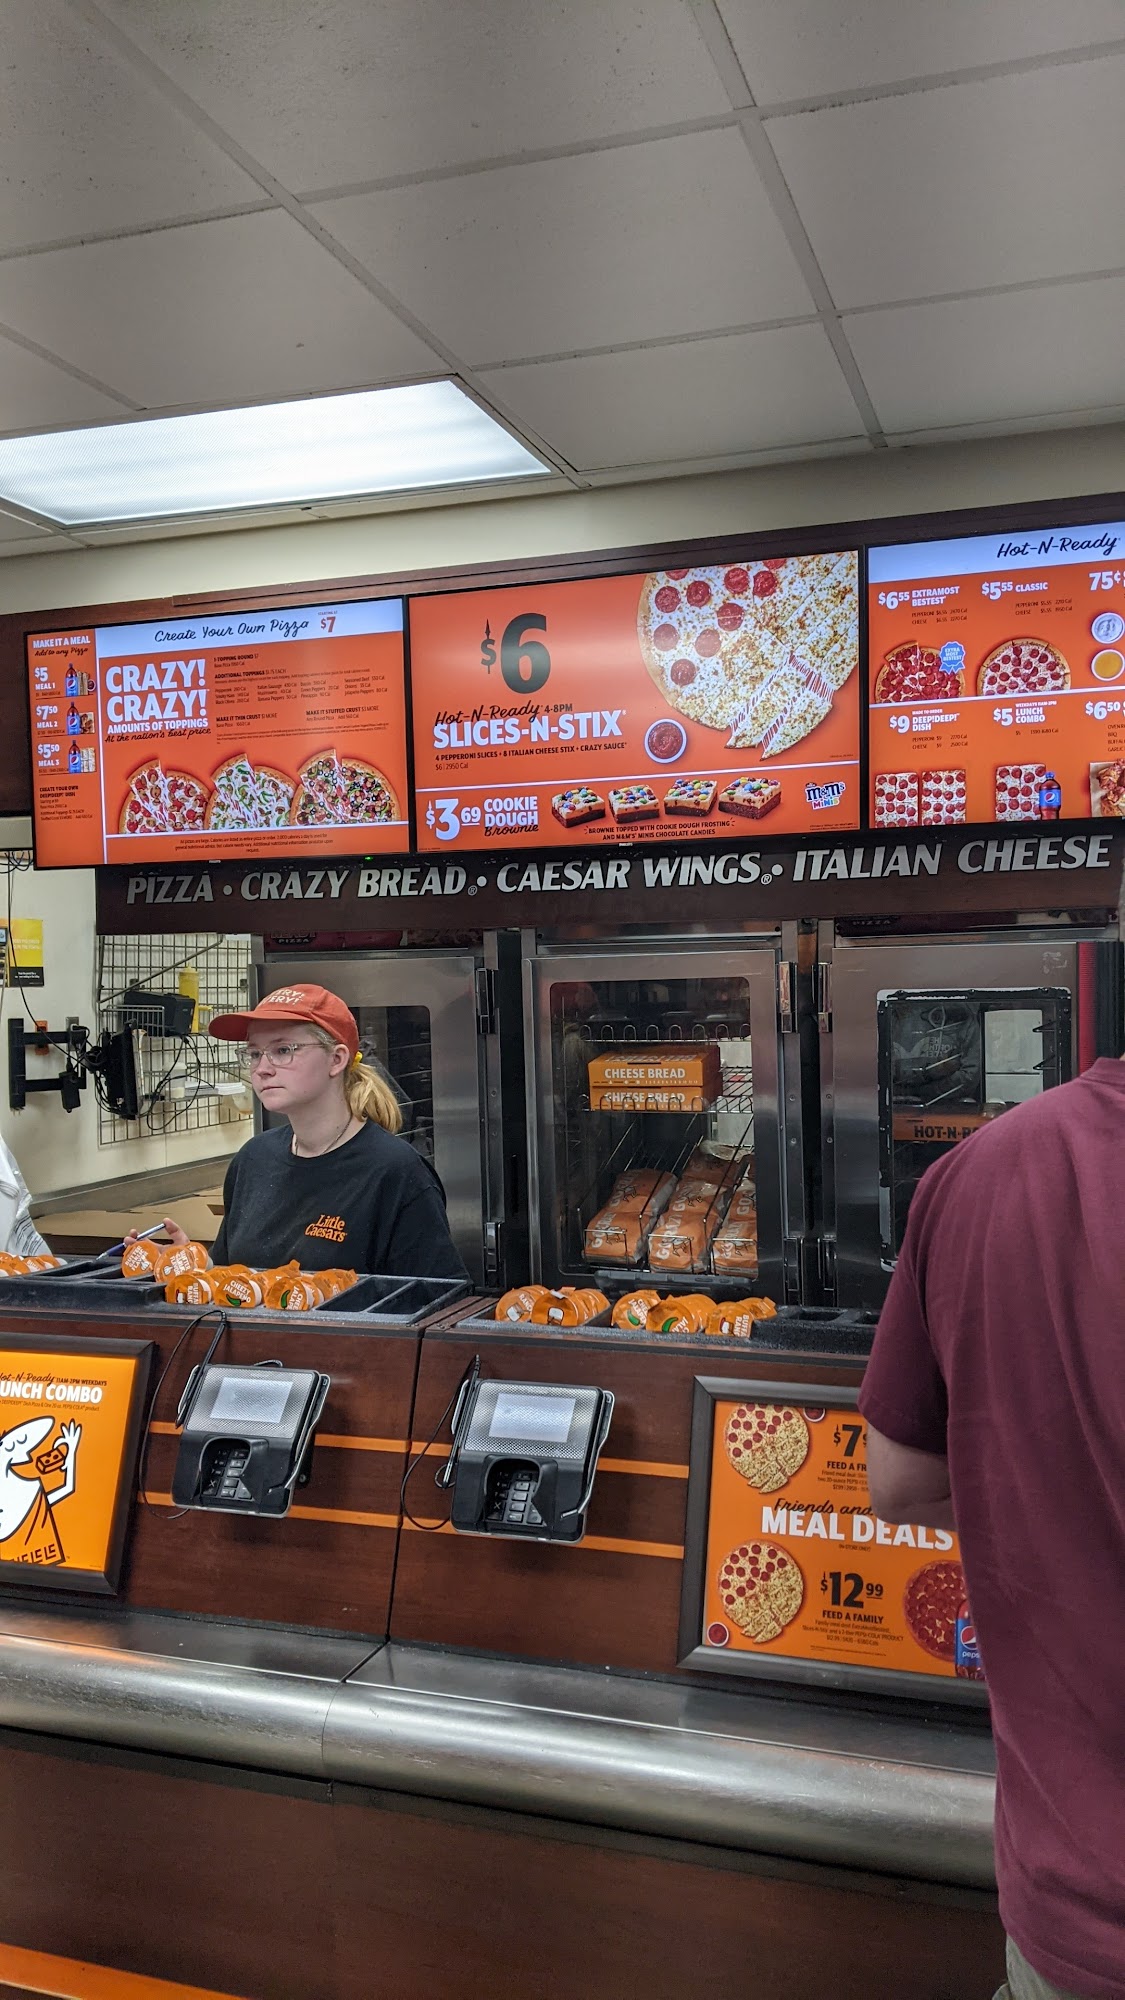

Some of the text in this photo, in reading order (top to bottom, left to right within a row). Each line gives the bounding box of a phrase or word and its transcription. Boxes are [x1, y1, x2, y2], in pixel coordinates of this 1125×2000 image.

[912, 586, 959, 598] EXTRAMOST
[1016, 582, 1047, 592] CLASSIC
[912, 596, 943, 607] BESTEST
[155, 619, 309, 643] Create Your Own Pizza
[321, 616, 336, 633] $7
[33, 636, 90, 649] MAKE IT A MEAL
[480, 613, 551, 694] $6
[35, 666, 49, 682] $5
[105, 659, 206, 694] CRAZY!
[36, 682, 50, 691] MEAL
[106, 689, 208, 724] CRAZY!
[1016, 707, 1043, 715] LUNCH
[37, 720, 53, 729] MEAL
[889, 715, 909, 733] $9
[993, 708, 1013, 726] $5
[1016, 714, 1045, 723] COMBO
[108, 722, 150, 735] AMOUNTS
[152, 720, 164, 731] OF
[165, 717, 208, 730] TOPPINGS
[912, 722, 931, 732] DISH
[105, 735, 115, 743] At
[117, 733, 129, 742] the
[168, 728, 186, 738] best
[187, 726, 211, 740] price
[441, 752, 476, 761] PEPPERONI
[477, 751, 498, 759] SLICES
[508, 748, 533, 757] ITALIAN
[535, 747, 558, 755] CHEESE
[580, 744, 602, 752] CRAZY
[38, 758, 54, 767] MEAL
[484, 796, 538, 812] COOKIE
[485, 811, 538, 827] DOUGH
[588, 826, 614, 834] BROWNIE
[656, 823, 677, 831] COOKIE
[701, 820, 730, 828] FROSTING
[484, 824, 539, 837] Brownie
[638, 831, 654, 839] MINIS
[656, 830, 683, 838] CHOCOLATE
[685, 828, 715, 836] CANDIES
[126, 872, 216, 905] PIZZA
[240, 868, 351, 901] CRAZY
[495, 858, 630, 894] CAESAR
[792, 843, 942, 882] ITALIAN
[957, 833, 1112, 873] CHEESE
[605, 1068, 685, 1078] CHEESE BREAD
[316, 1214, 345, 1230] Little
[305, 1223, 346, 1242] Caesars
[81, 1379, 107, 1387] WEEKDAYS
[45, 1383, 103, 1404] COMBO
[827, 1461, 847, 1470] FEED
[773, 1498, 835, 1514] Friends
[761, 1506, 953, 1550] MEAL DEALS
[822, 1610, 884, 1624] FEED A FAMILY
